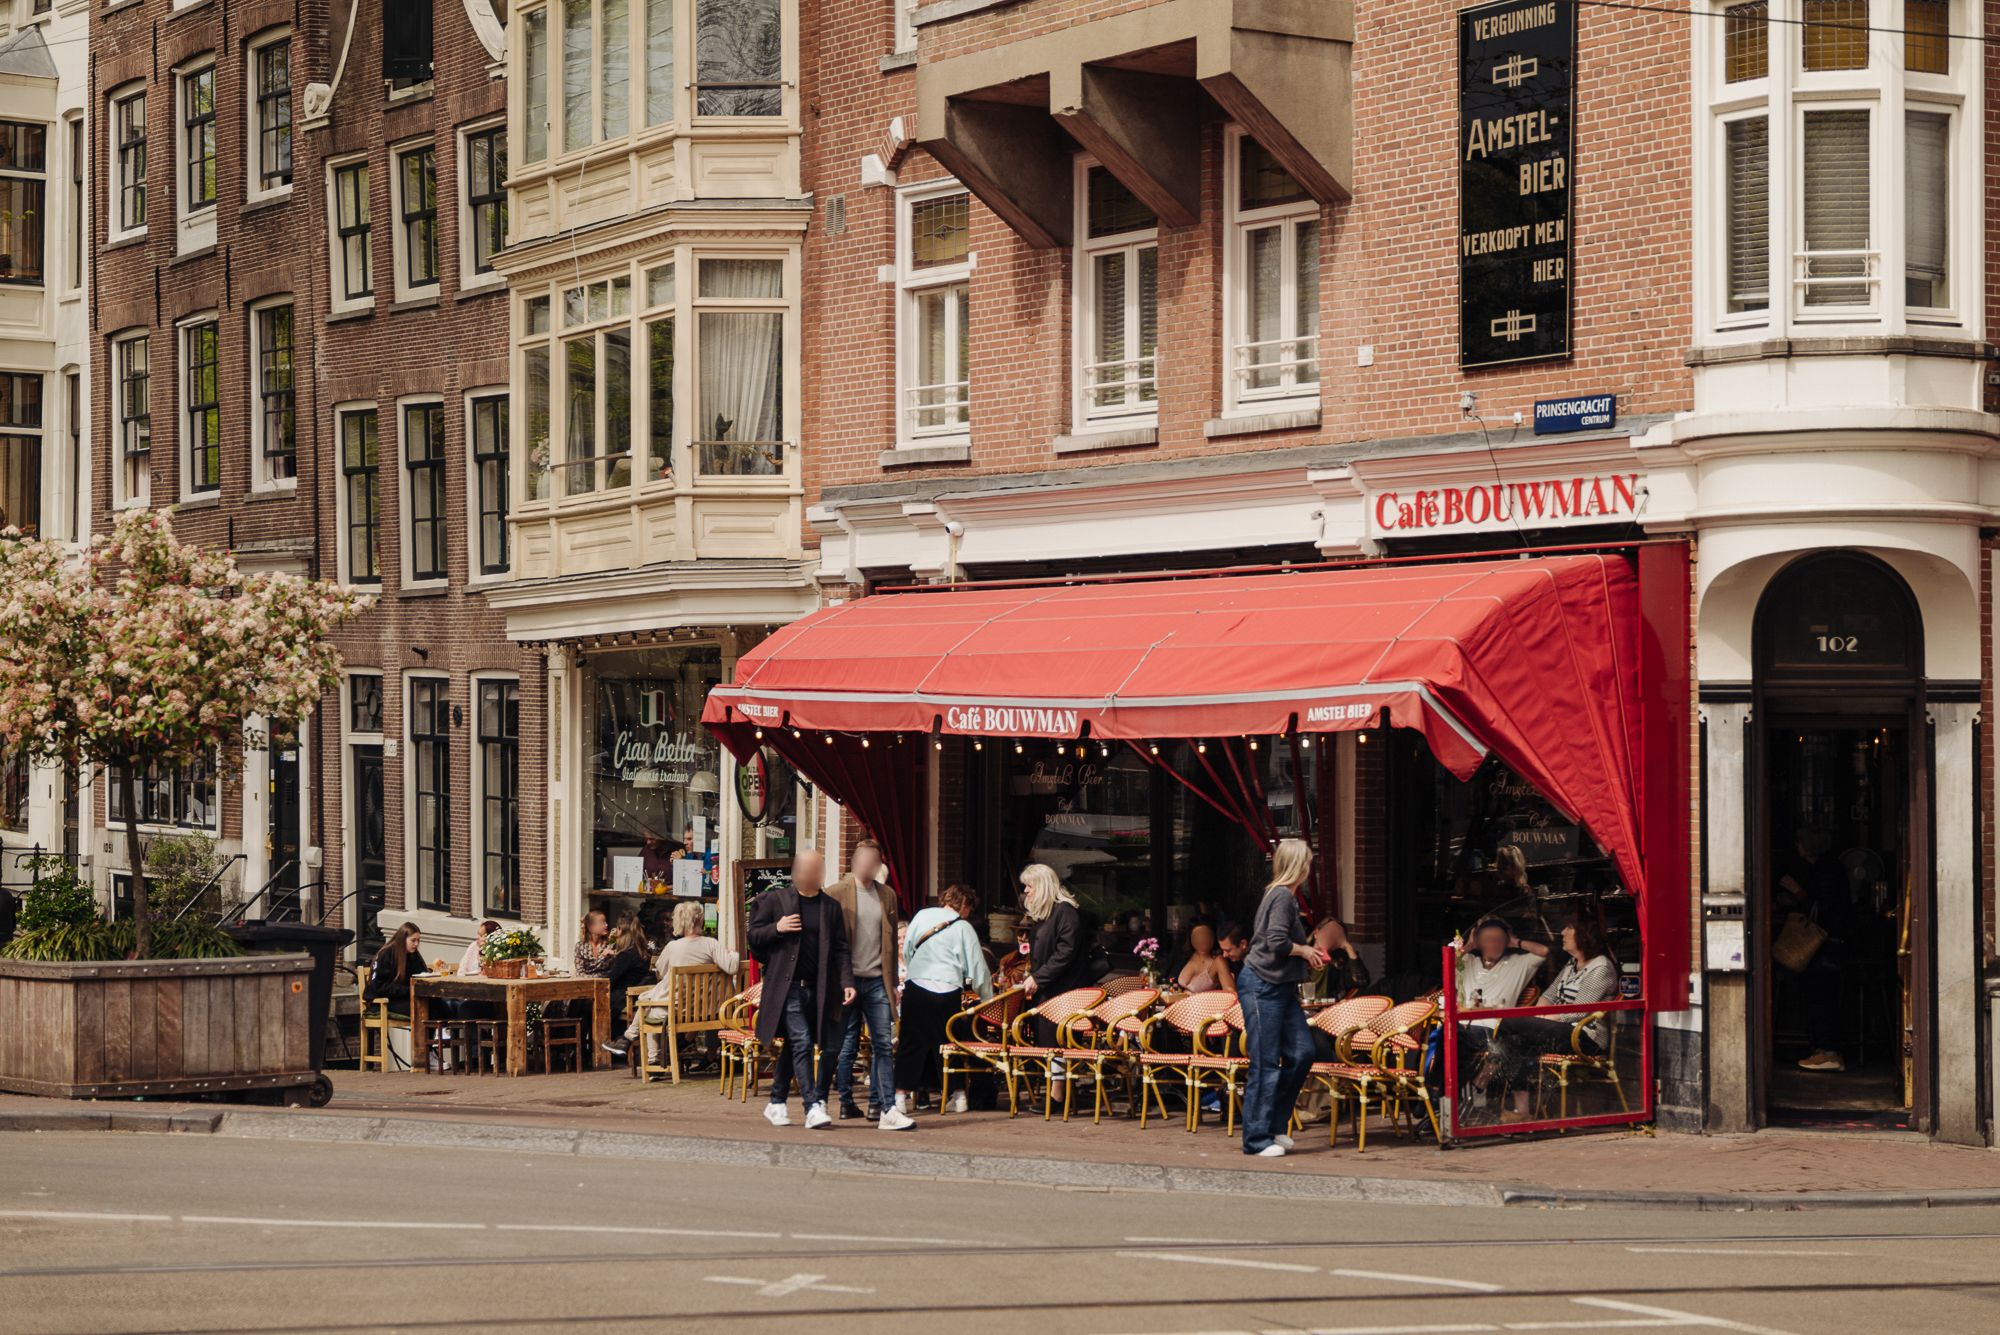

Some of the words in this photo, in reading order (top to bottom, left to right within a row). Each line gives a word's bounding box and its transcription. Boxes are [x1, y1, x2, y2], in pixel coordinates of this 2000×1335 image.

[1474, 1, 1556, 40] VERGUNNING
[1519, 156, 1565, 196] BIER
[1462, 225, 1530, 257] VERKOOPT
[1535, 219, 1564, 245] MEN
[1533, 256, 1564, 283] HIER
[1536, 397, 1611, 418] PRINSENGRACHT
[1581, 414, 1610, 425] CENTRUM
[1376, 489, 1439, 530] Café
[1442, 473, 1638, 525] BOUWMAN
[1816, 636, 1858, 652] 102
[763, 705, 779, 718] BIER
[947, 706, 981, 731] Café
[984, 707, 1078, 733] BOUWMAN
[1307, 705, 1347, 721] AMSTEL
[1347, 703, 1372, 719] BIER
[614, 730, 650, 769] Ciao
[654, 731, 696, 763] Bella
[741, 774, 766, 790] OPEN
[1045, 814, 1086, 825] BOUWMAN
[1512, 832, 1567, 845] BOUWMAN
